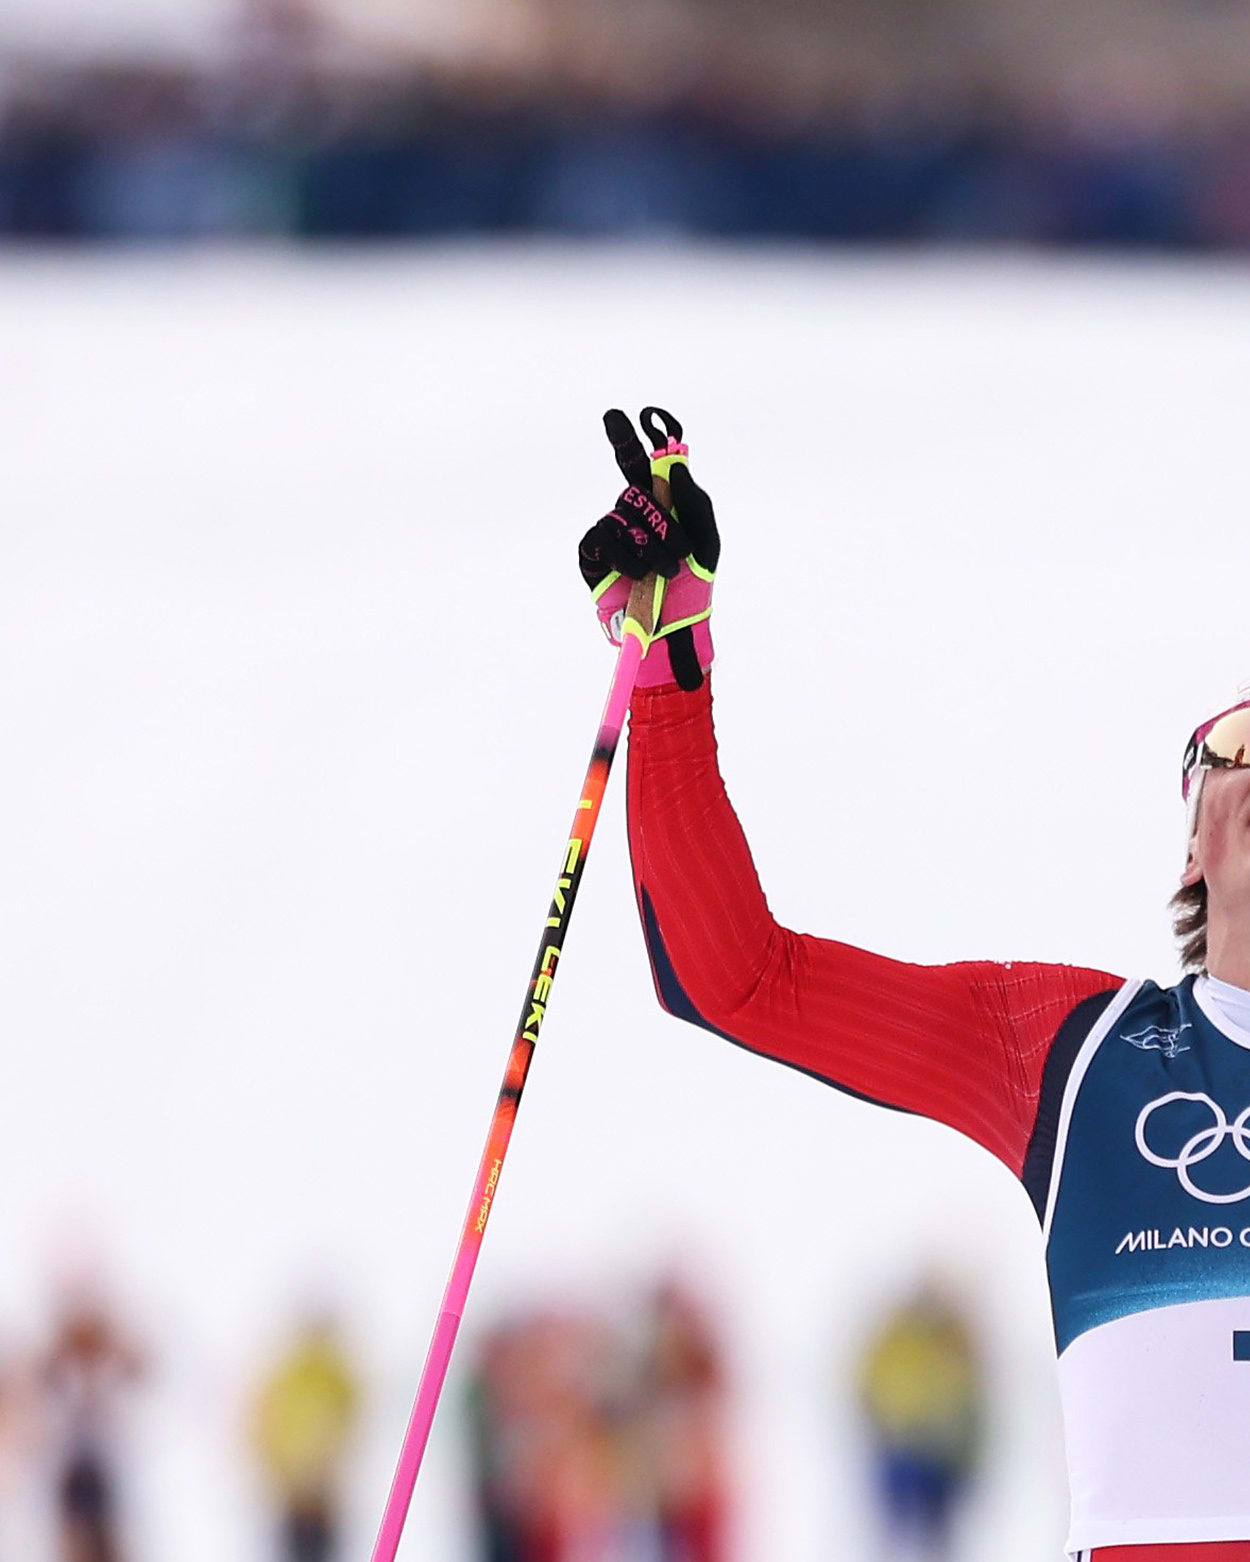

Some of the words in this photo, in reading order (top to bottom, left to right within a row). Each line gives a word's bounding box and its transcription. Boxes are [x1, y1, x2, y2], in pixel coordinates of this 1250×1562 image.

[622, 486, 669, 540] ESTRA
[522, 946, 561, 1043] LEKI
[1115, 1226, 1233, 1255] MILANO
